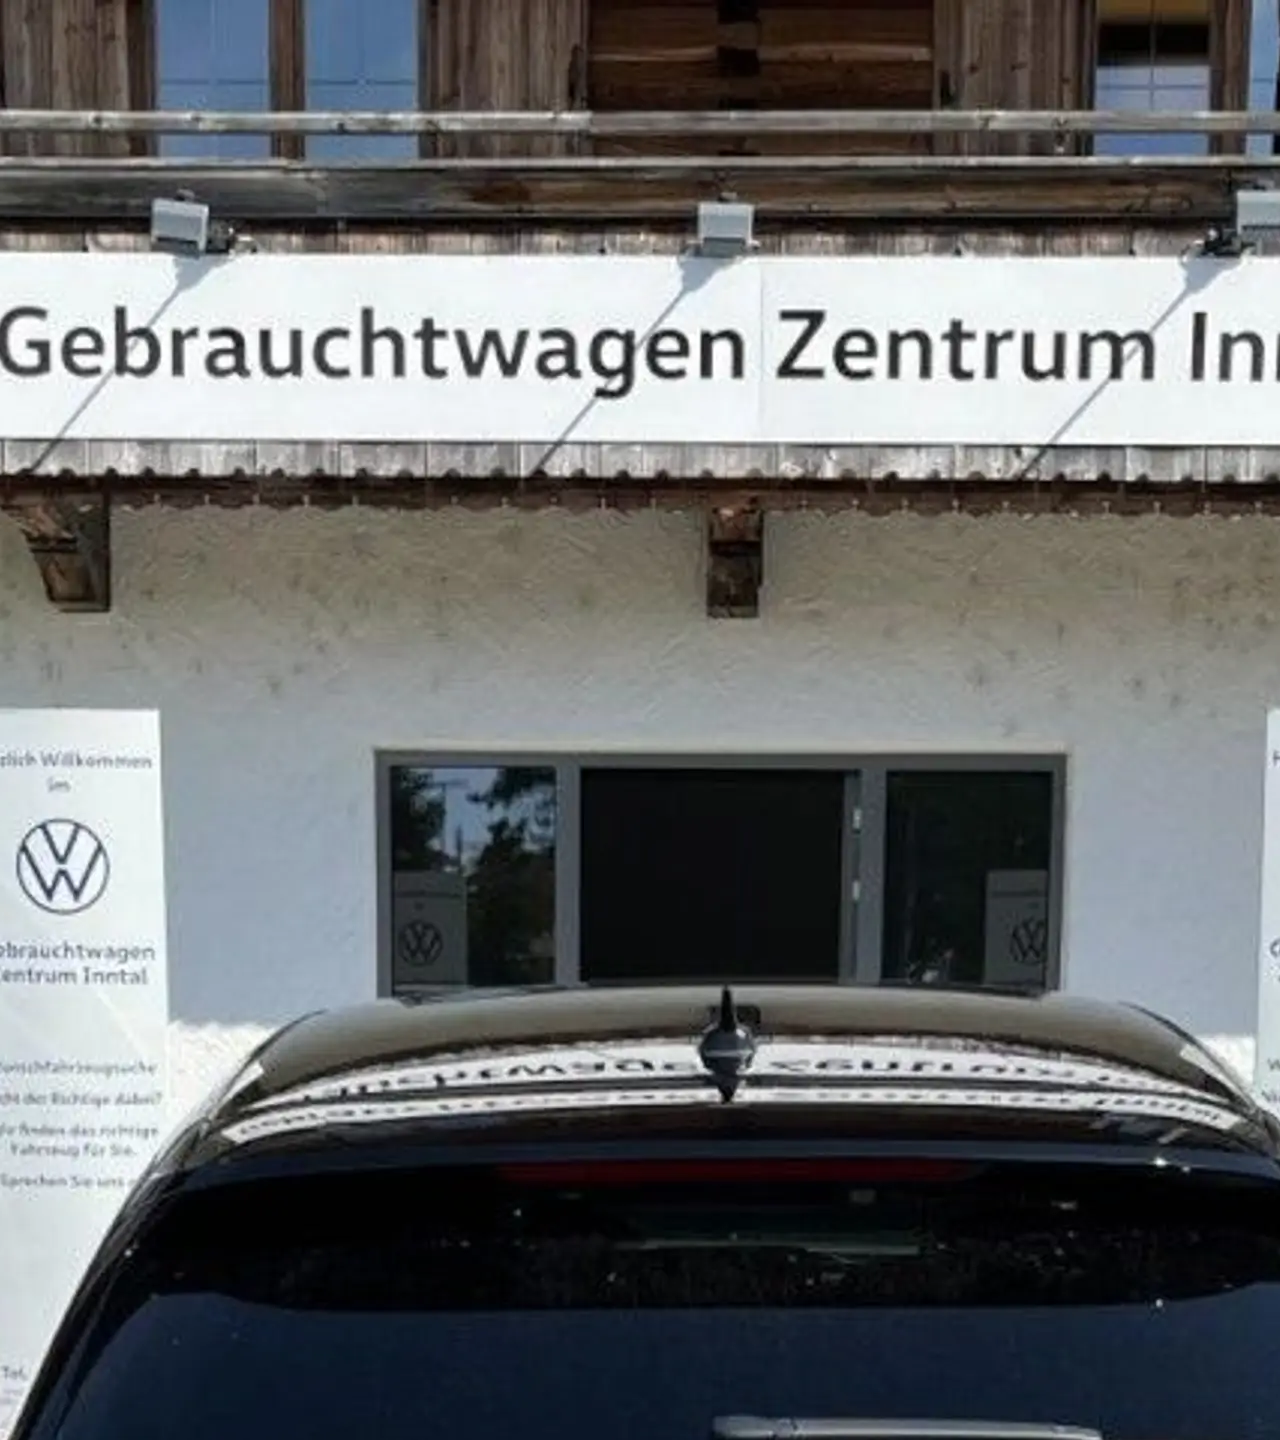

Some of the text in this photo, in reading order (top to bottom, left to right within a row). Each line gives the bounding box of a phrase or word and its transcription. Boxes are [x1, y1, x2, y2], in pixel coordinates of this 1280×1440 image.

[776, 310, 1156, 382] Zentrum
[40, 750, 153, 770] Willkommen
[47, 775, 72, 793] im
[83, 967, 149, 986] Inntal
